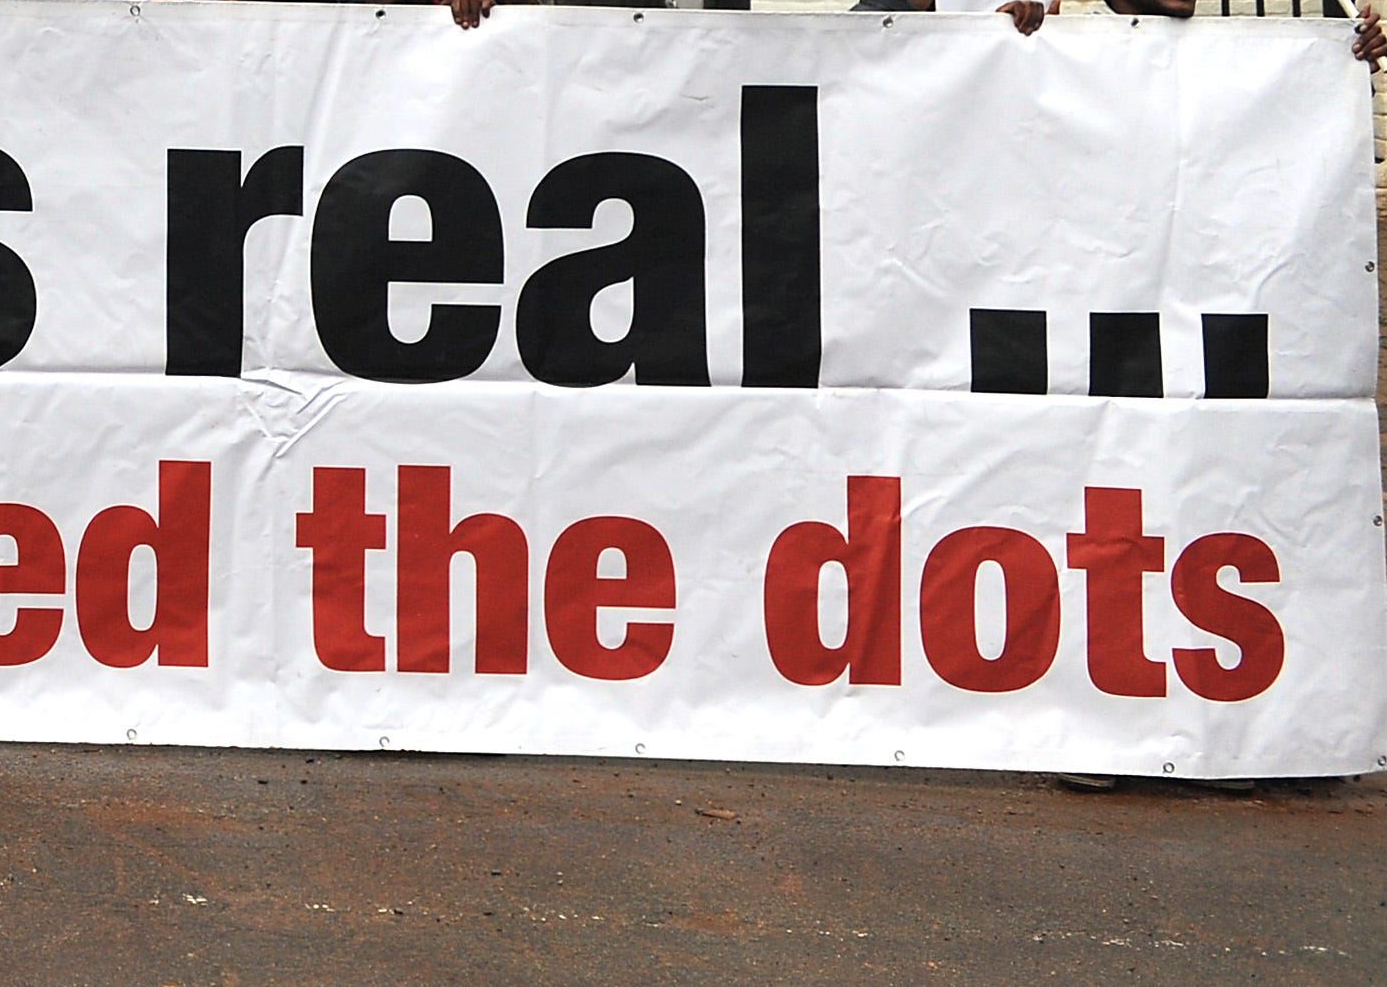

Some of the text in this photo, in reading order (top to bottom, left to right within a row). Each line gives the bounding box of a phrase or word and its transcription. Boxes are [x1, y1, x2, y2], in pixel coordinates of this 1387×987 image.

[165, 85, 822, 389] real
[296, 465, 677, 681] the
[764, 475, 1285, 702] dots
